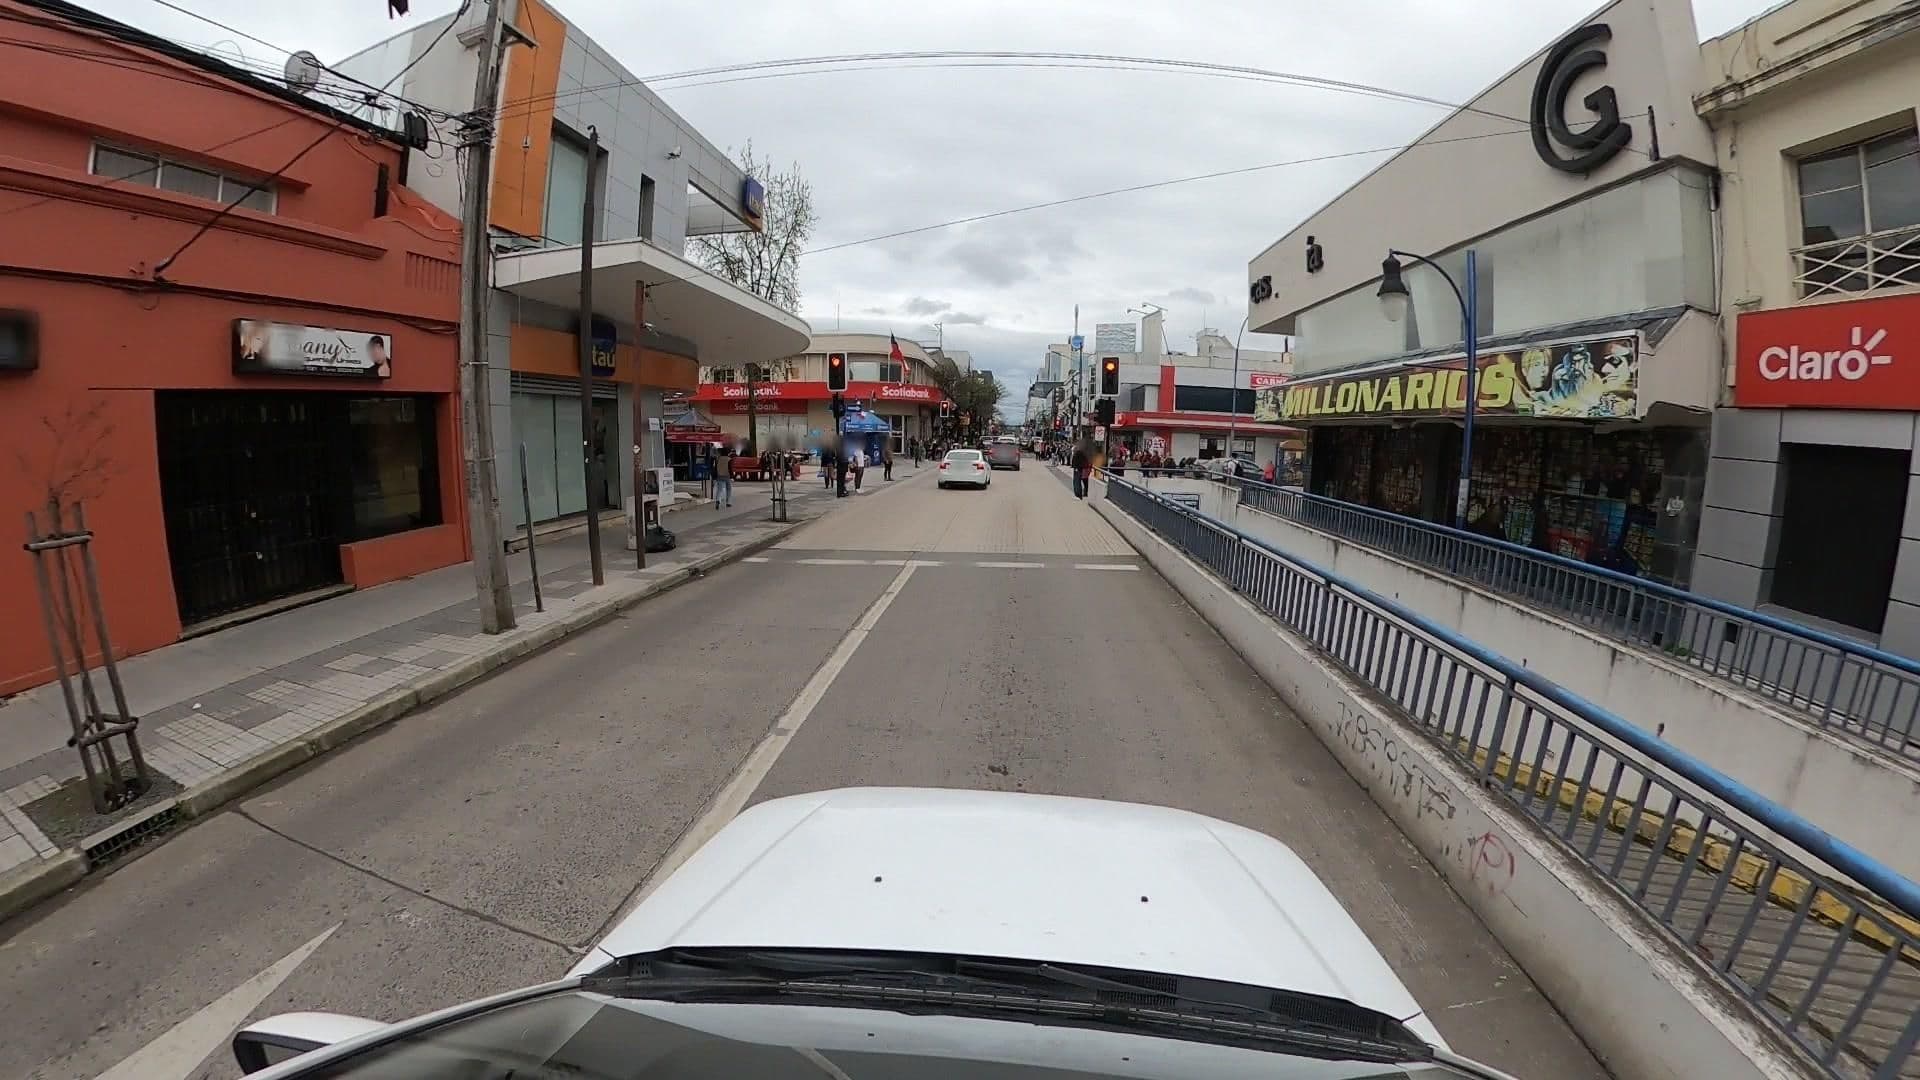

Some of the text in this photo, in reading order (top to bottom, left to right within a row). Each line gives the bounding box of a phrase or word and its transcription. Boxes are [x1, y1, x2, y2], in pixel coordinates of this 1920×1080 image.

[1759, 345, 1868, 380] Claro
[882, 386, 930, 399] Scotiabank
[1284, 357, 1518, 417] MILLONARIOS
